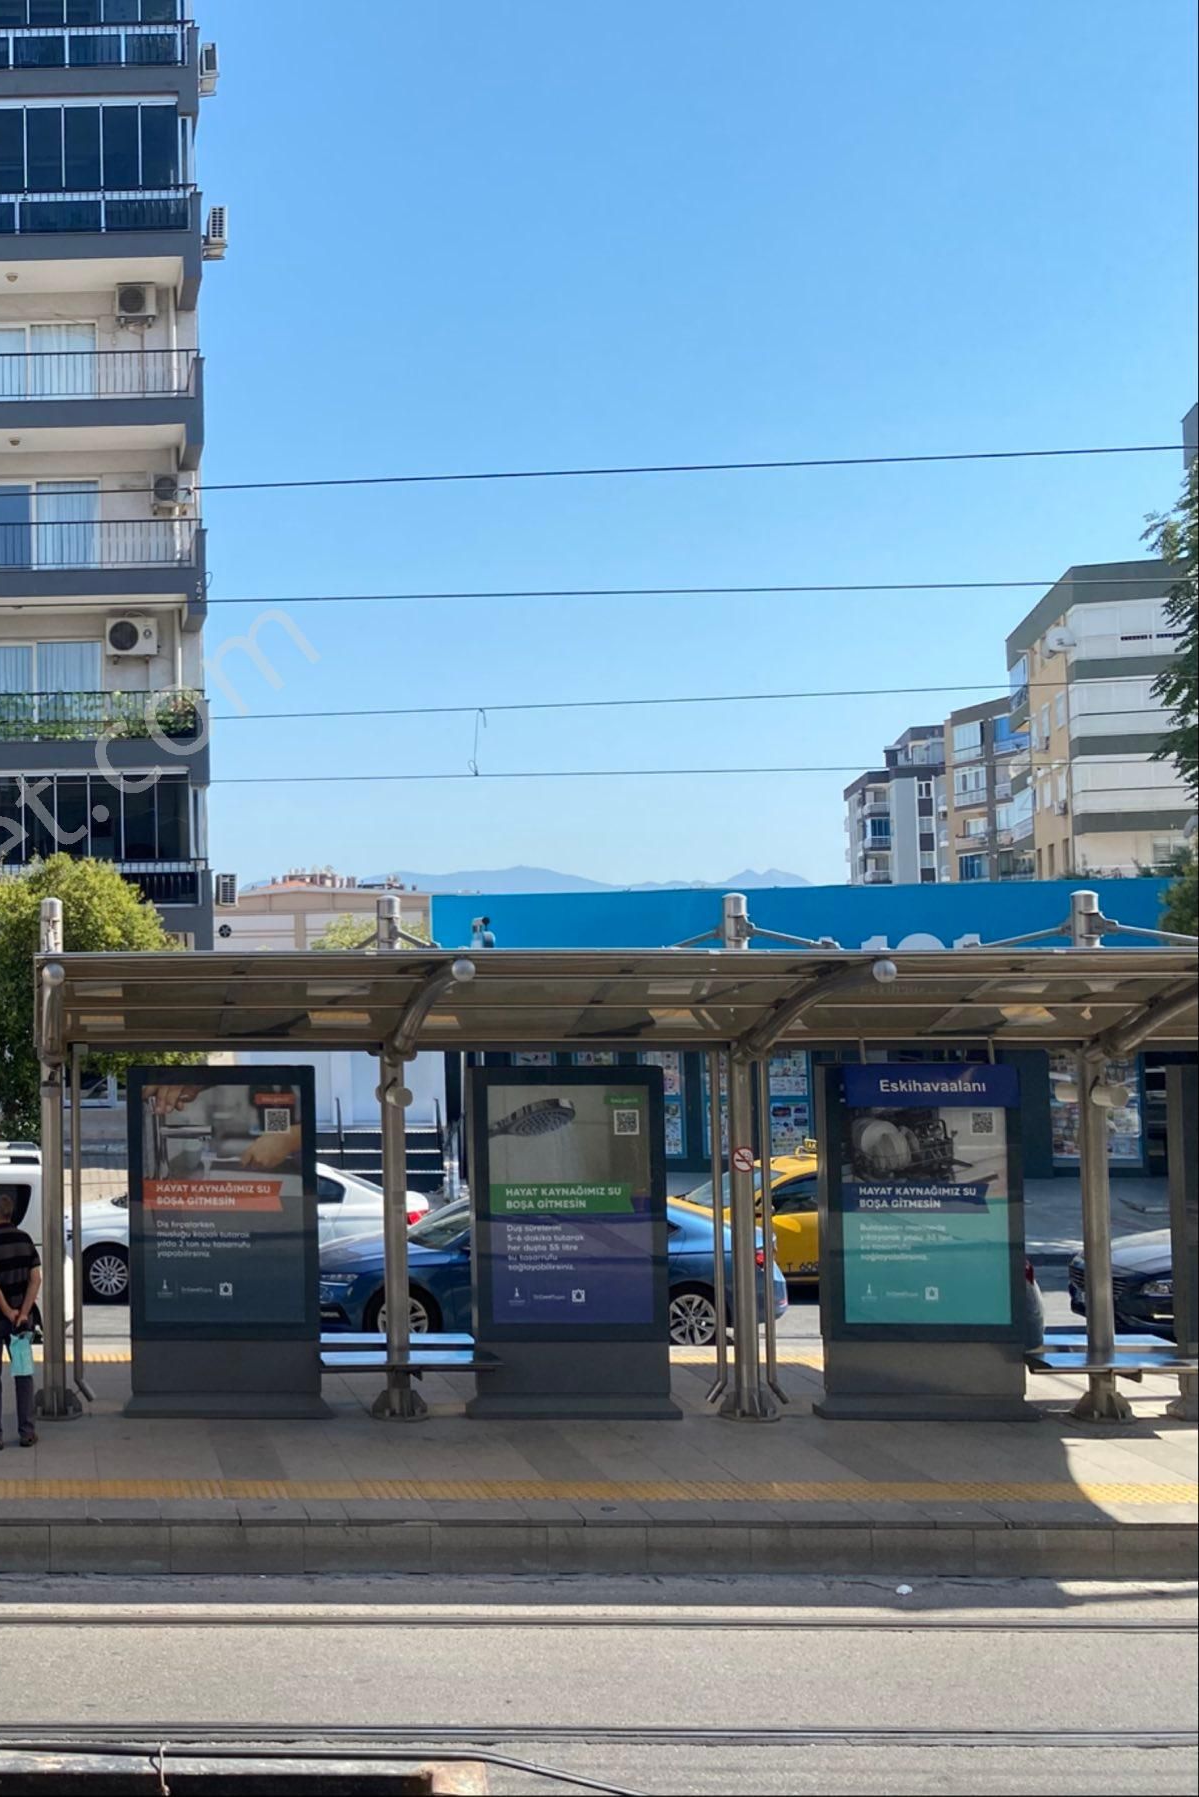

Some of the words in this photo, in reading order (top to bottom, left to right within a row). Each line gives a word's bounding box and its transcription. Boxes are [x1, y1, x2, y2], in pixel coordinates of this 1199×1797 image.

[879, 1079, 986, 1092] Eskihavaalanı
[156, 1184, 188, 1193] HAYAT
[191, 1182, 254, 1194] KAYNAĞIMIZ
[256, 1185, 270, 1194] SU
[506, 1188, 538, 1196] HAYAT
[540, 1186, 604, 1196] KAYNAĞIMIZ
[608, 1187, 621, 1196] SU
[859, 1187, 892, 1195] HAYAT
[895, 1186, 960, 1196] KAYNAĞIMIZ
[963, 1187, 976, 1196] SU
[156, 1197, 184, 1206] BOŞA
[187, 1196, 236, 1206] GİTMESİN
[506, 1200, 534, 1210] BOŞA
[537, 1198, 586, 1208] GİTMESİN
[860, 1200, 888, 1209] BOŞA
[891, 1198, 941, 1208] GİTMESİN
